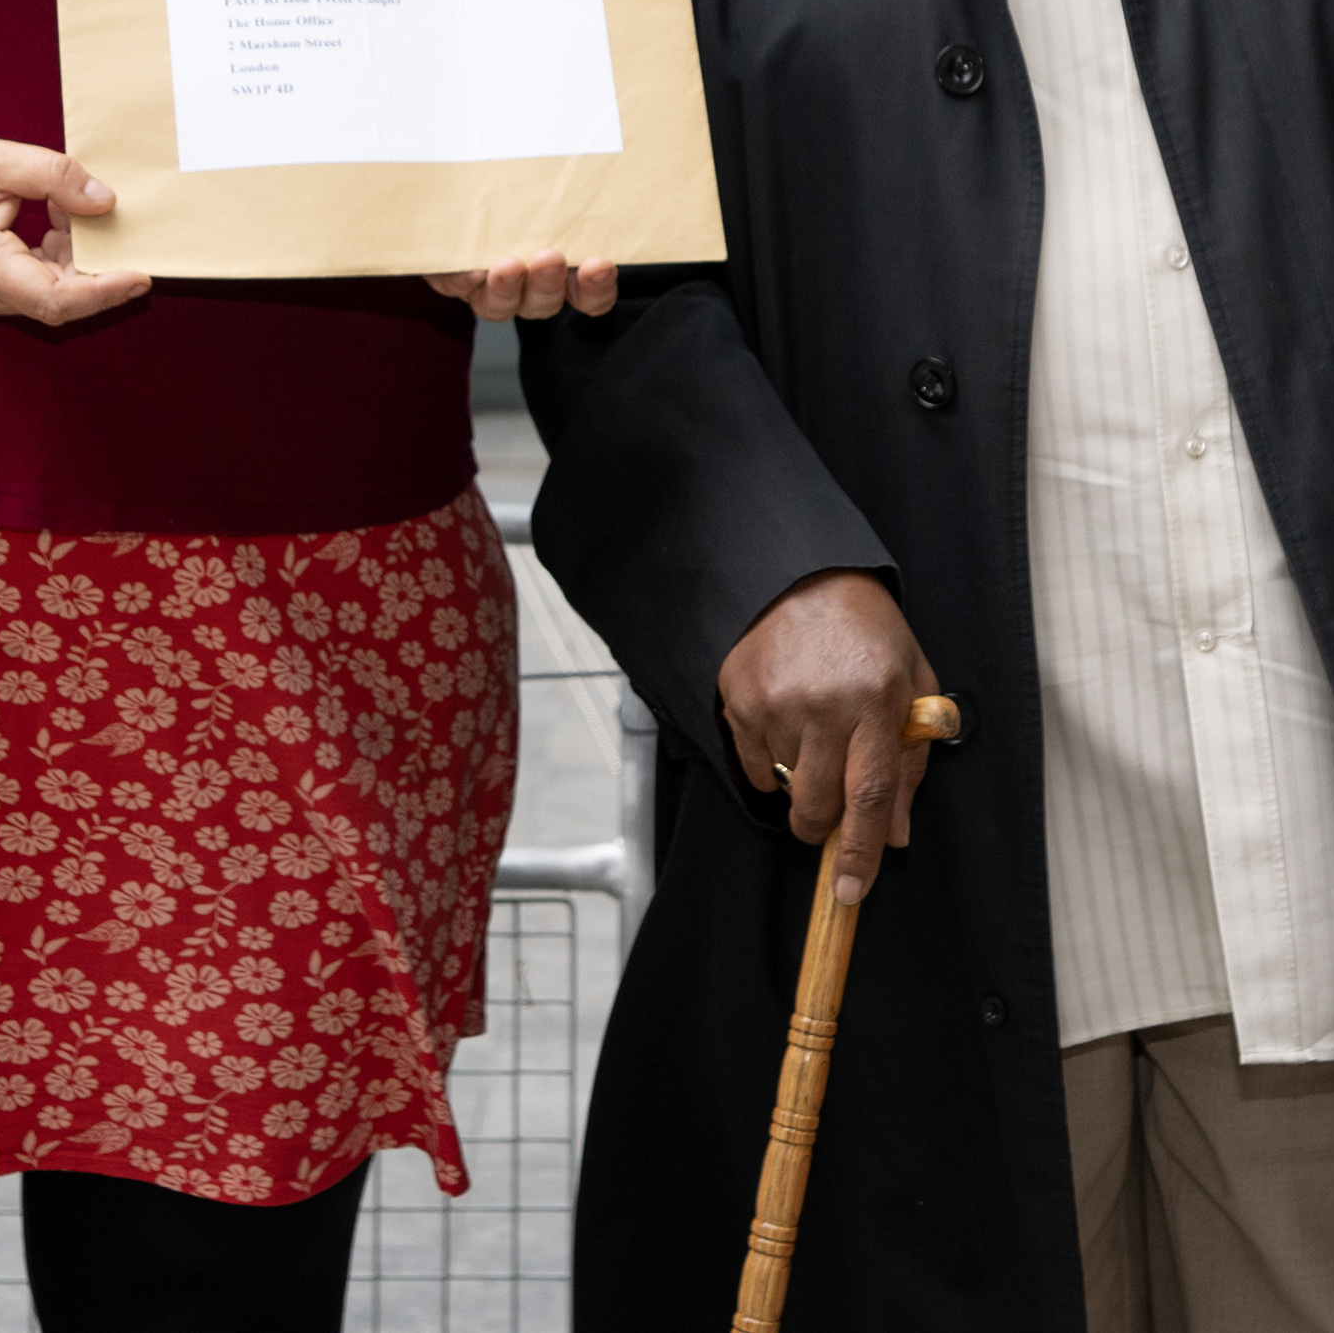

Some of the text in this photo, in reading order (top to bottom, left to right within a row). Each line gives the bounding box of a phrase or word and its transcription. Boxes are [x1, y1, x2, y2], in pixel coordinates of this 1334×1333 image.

[227, 15, 334, 28] The Home Office
[228, 38, 342, 50] 2 Marsham Street
[231, 62, 279, 73] London
[232, 83, 293, 95] SW1P 4D
